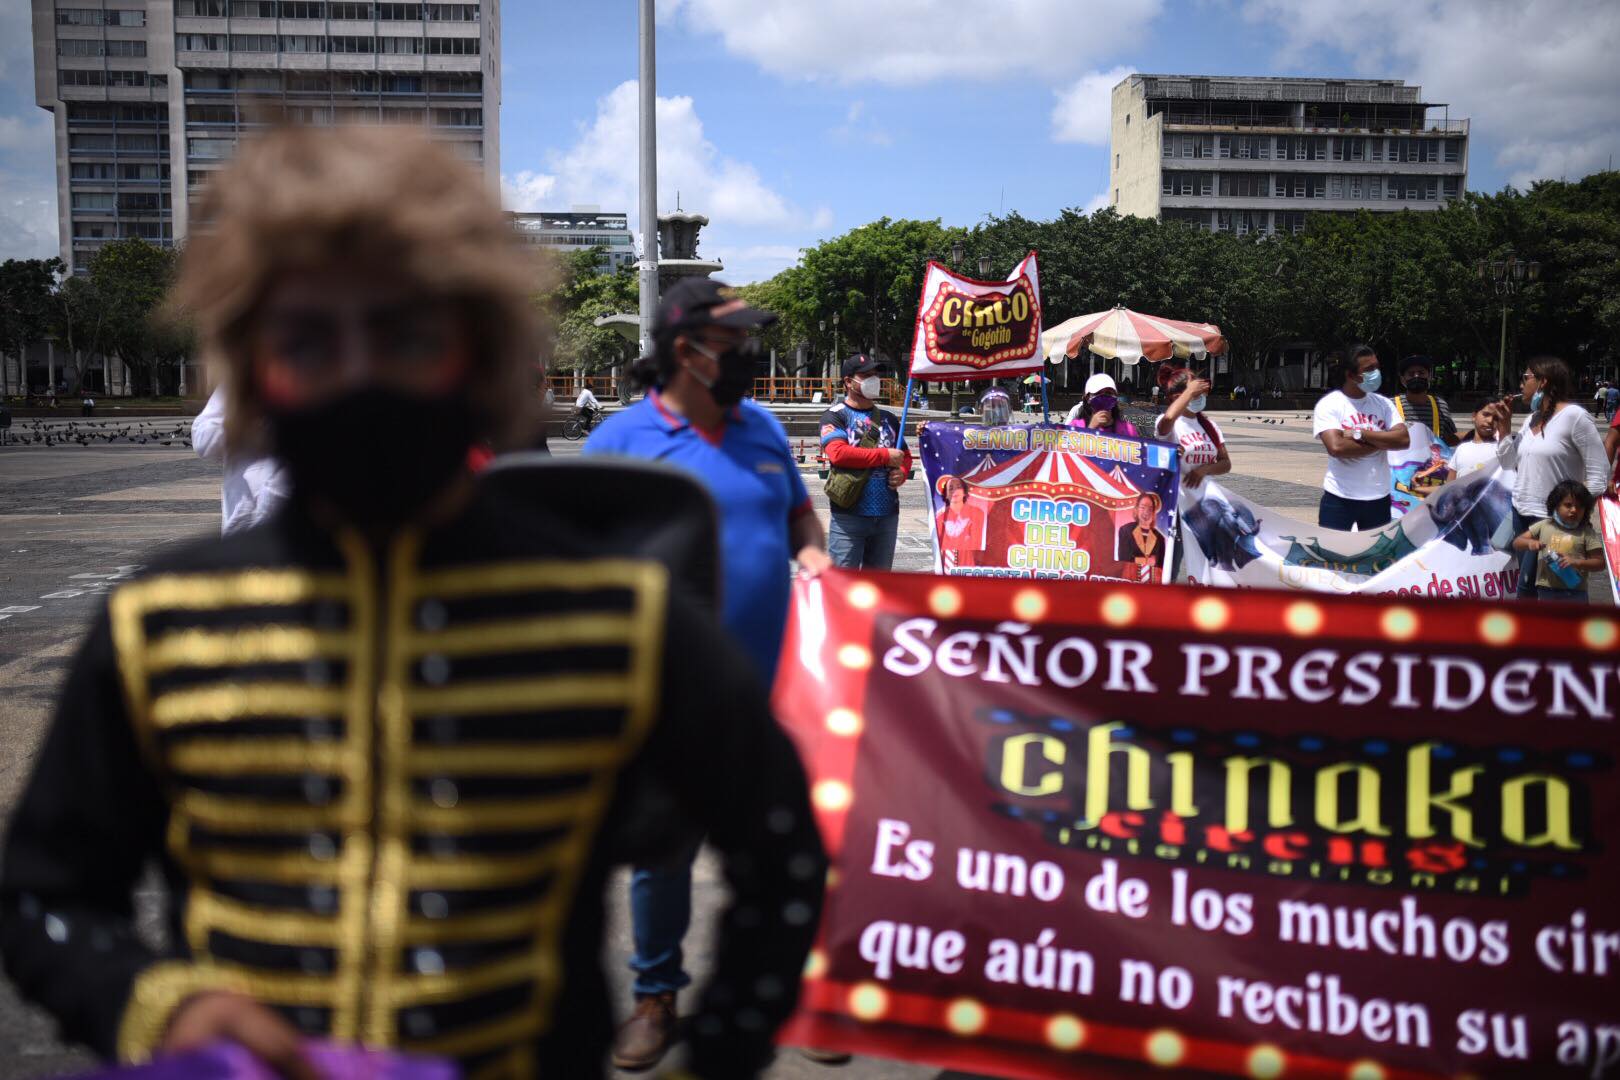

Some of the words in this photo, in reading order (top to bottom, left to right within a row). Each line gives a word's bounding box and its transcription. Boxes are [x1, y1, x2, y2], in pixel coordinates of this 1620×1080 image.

[942, 292, 1028, 327] CIRCO
[962, 329, 972, 337] de
[971, 325, 1011, 350] Gogotito
[963, 428, 1028, 450] SEÑOR
[1031, 429, 1142, 465] PRESIDENTE
[1013, 498, 1090, 526] CIRCO
[1026, 522, 1075, 548] DEL
[1008, 546, 1089, 573] CHINO
[1427, 572, 1453, 600] de
[1456, 575, 1481, 600] su
[883, 617, 1157, 694] SEÑOR
[1180, 643, 1620, 719] PRESIDEN
[870, 817, 935, 882] Es
[956, 846, 1065, 902] uno
[1084, 858, 1150, 919] de
[1171, 868, 1255, 935] los
[1278, 896, 1510, 966] muchos
[1535, 910, 1620, 975] cir
[858, 919, 966, 980] que
[984, 928, 1096, 996] aún
[1119, 957, 1194, 1010] no
[1217, 971, 1431, 1048] reciben
[1456, 1006, 1530, 1060] su
